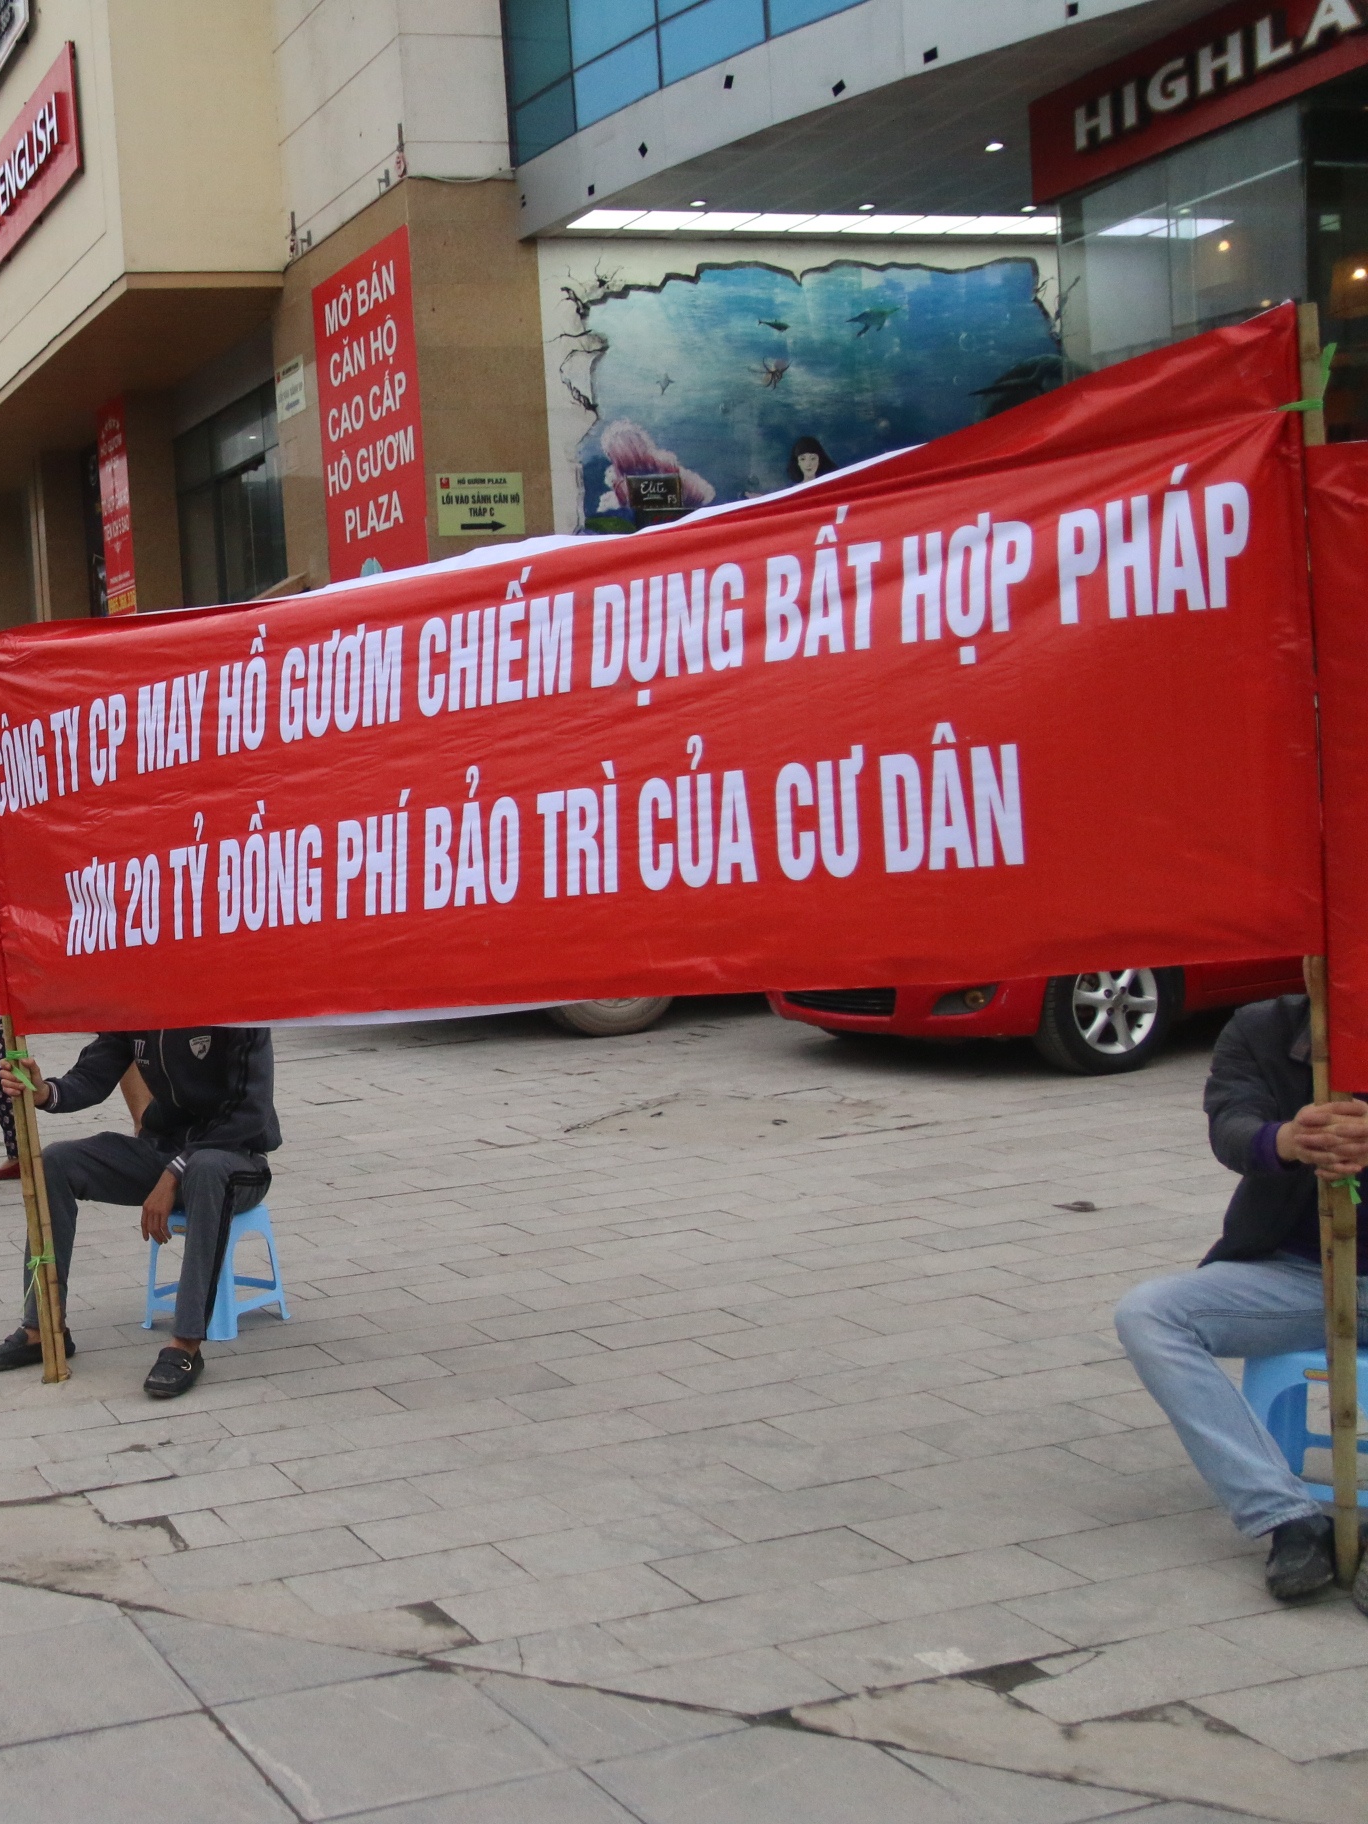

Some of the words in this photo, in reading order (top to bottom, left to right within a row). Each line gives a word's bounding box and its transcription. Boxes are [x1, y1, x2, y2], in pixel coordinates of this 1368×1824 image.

[324, 284, 351, 337] MỞ
[357, 260, 395, 317] BÁN
[330, 336, 366, 387] CĂN
[371, 315, 397, 364] HỘ
[328, 395, 364, 442] CAO
[369, 370, 406, 422] CẤP
[327, 451, 352, 497] HỒ
[357, 425, 415, 484] GƯƠM
[345, 490, 403, 543] PLAZA
[50, 705, 80, 796] TY
[89, 693, 127, 786] CP
[136, 669, 208, 774] MAY
[217, 624, 267, 756] HỒ
[279, 624, 403, 743] GƯƠM
[418, 566, 574, 717] CHIẾM
[590, 562, 745, 706] DỤNG
[765, 505, 881, 662] BẤT
[901, 511, 1032, 665] HỢP
[1057, 463, 1250, 625] PHÁP
[65, 857, 117, 957] HƠN
[124, 854, 160, 947] 20
[169, 811, 208, 940] TỶ
[217, 800, 322, 935] ĐỒNG
[336, 788, 411, 919] PHÍ
[423, 765, 520, 910] BẢO
[536, 760, 618, 899] TRÌ
[638, 734, 758, 891] CỦA
[775, 745, 863, 881] CƯ
[879, 722, 1024, 873] DÂN
